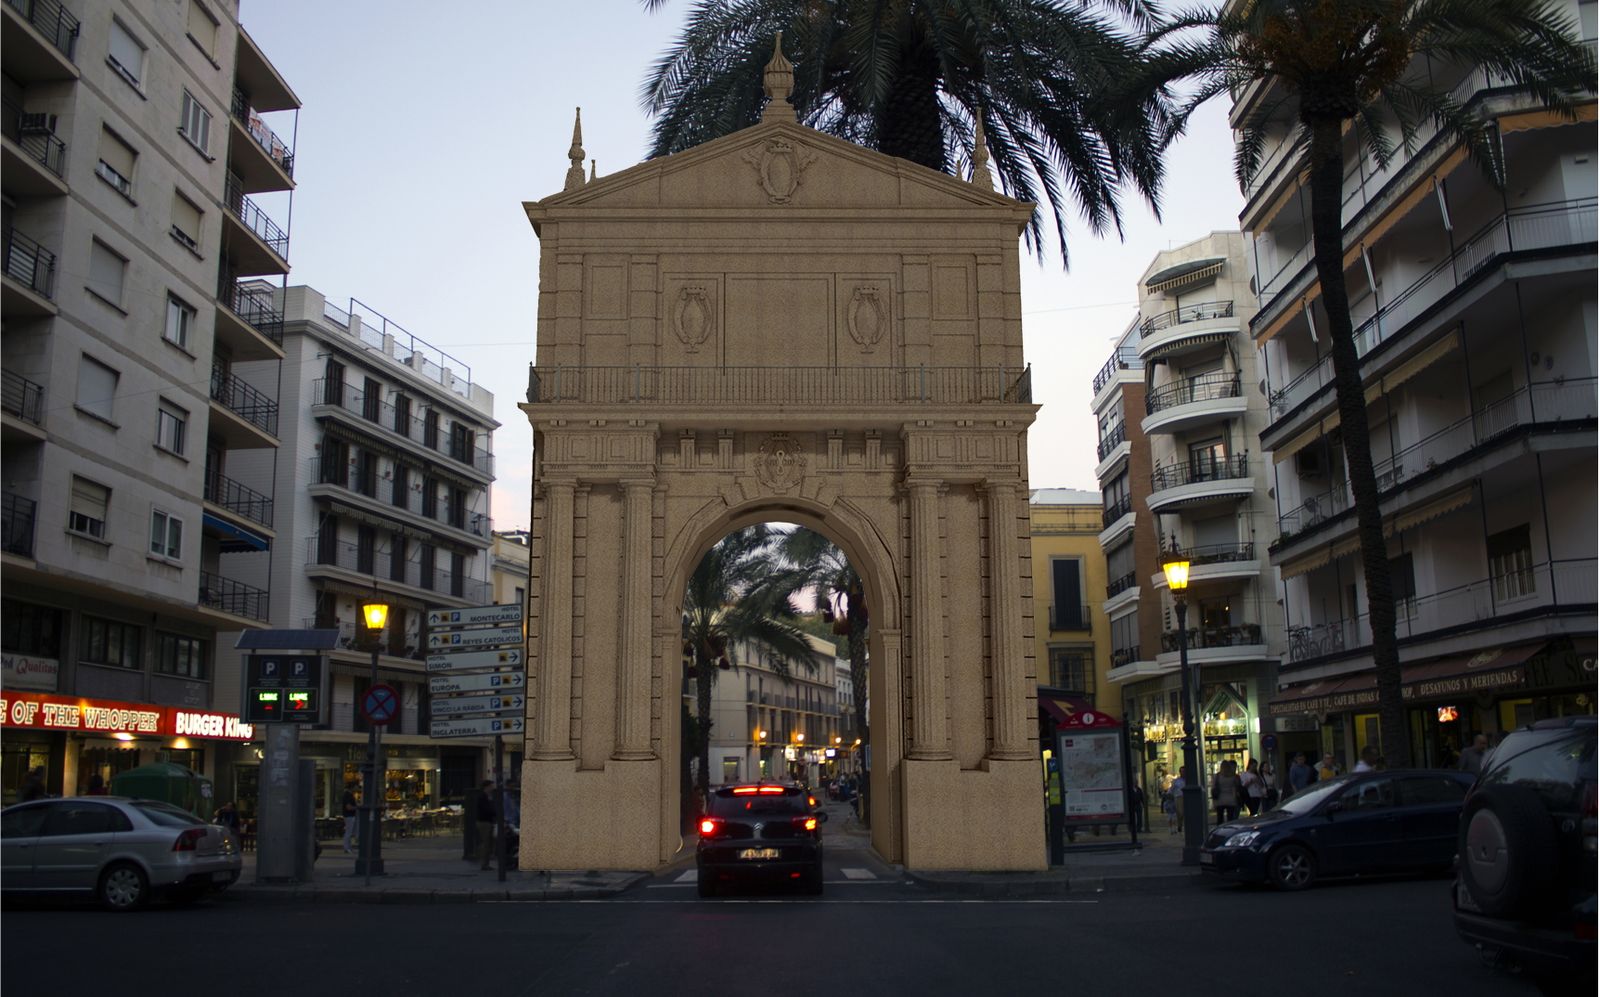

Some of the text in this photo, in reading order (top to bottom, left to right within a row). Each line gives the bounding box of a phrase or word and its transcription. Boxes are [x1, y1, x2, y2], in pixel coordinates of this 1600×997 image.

[470, 613, 520, 622] MONTECARLO
[1420, 680, 1460, 695] DESAYUNOS
[1463, 678, 1469, 690] Y
[1471, 670, 1518, 688] MERIENDAS
[11, 700, 39, 725] OF
[42, 703, 80, 728] THE
[175, 712, 253, 739] BURGER KING
